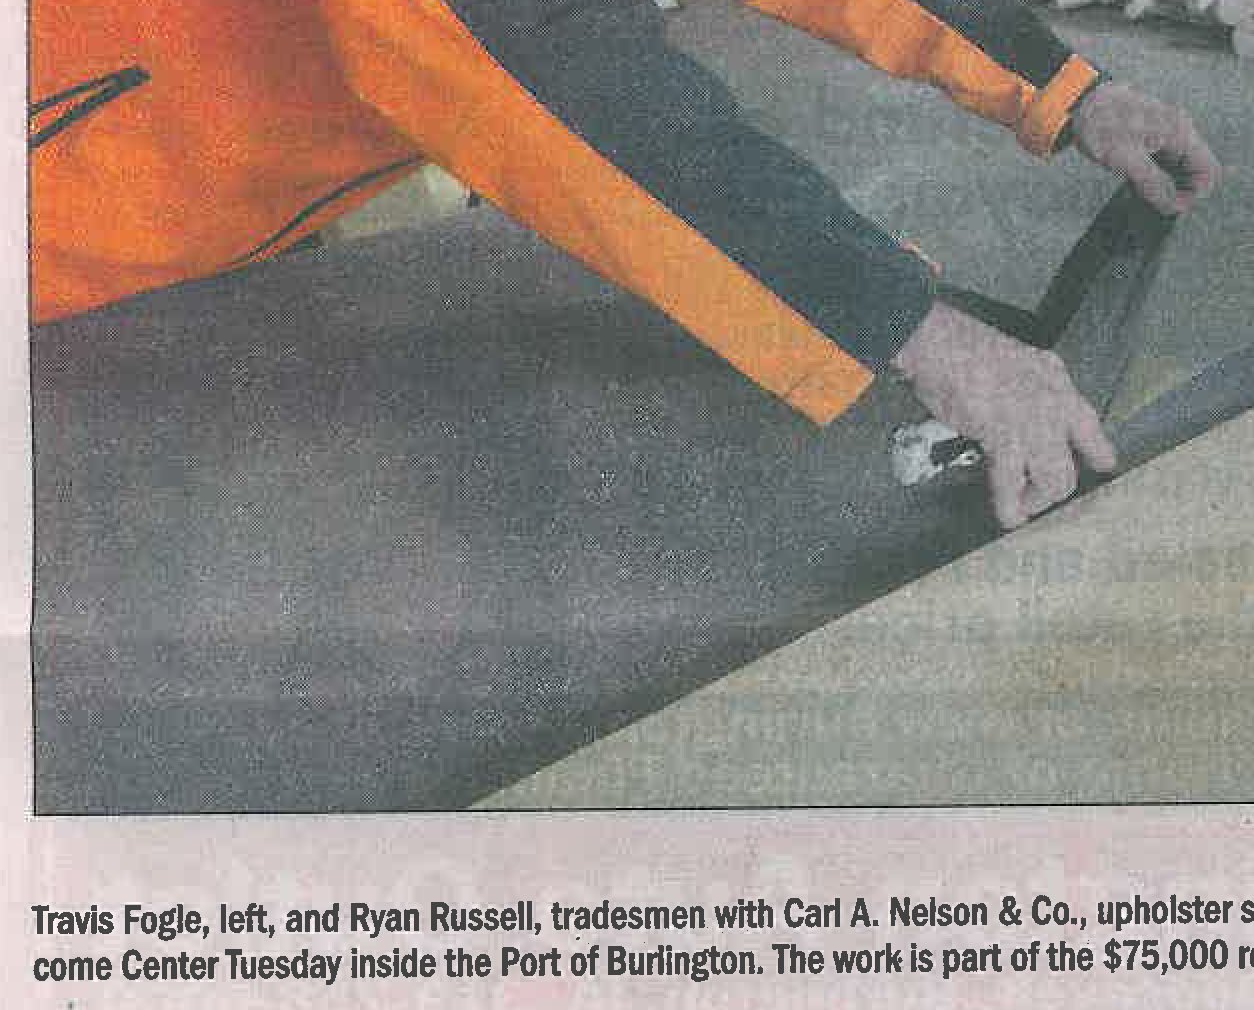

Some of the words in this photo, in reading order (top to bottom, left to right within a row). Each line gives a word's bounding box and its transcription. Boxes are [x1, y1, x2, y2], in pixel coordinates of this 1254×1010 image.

[31, 905, 114, 934] Travis
[125, 904, 209, 941] Fogle,
[221, 903, 275, 938] left,
[286, 903, 339, 932] and
[351, 903, 419, 938] Ryan
[431, 901, 541, 935] Russell,
[551, 900, 705, 931] tradesmen
[714, 899, 773, 928] with
[784, 898, 840, 928] Carl
[850, 898, 879, 927] A.
[890, 897, 987, 926] Nelson
[999, 896, 1022, 926] &
[1032, 895, 1086, 930] Co.,
[1098, 894, 1233, 931] upholster
[33, 957, 112, 981] come
[122, 949, 219, 980] Center
[225, 949, 342, 985] Tuesday
[351, 948, 436, 978] inside
[444, 948, 491, 977] the
[502, 947, 561, 976] Port
[571, 945, 599, 976] of
[608, 945, 763, 982] Burlington.
[772, 944, 824, 974] The
[833, 943, 903, 973] work
[911, 943, 933, 972] is
[943, 944, 1002, 979] part
[1011, 941, 1040, 971] of
[1046, 941, 1093, 971] the
[1103, 938, 1228, 975] $75,000
